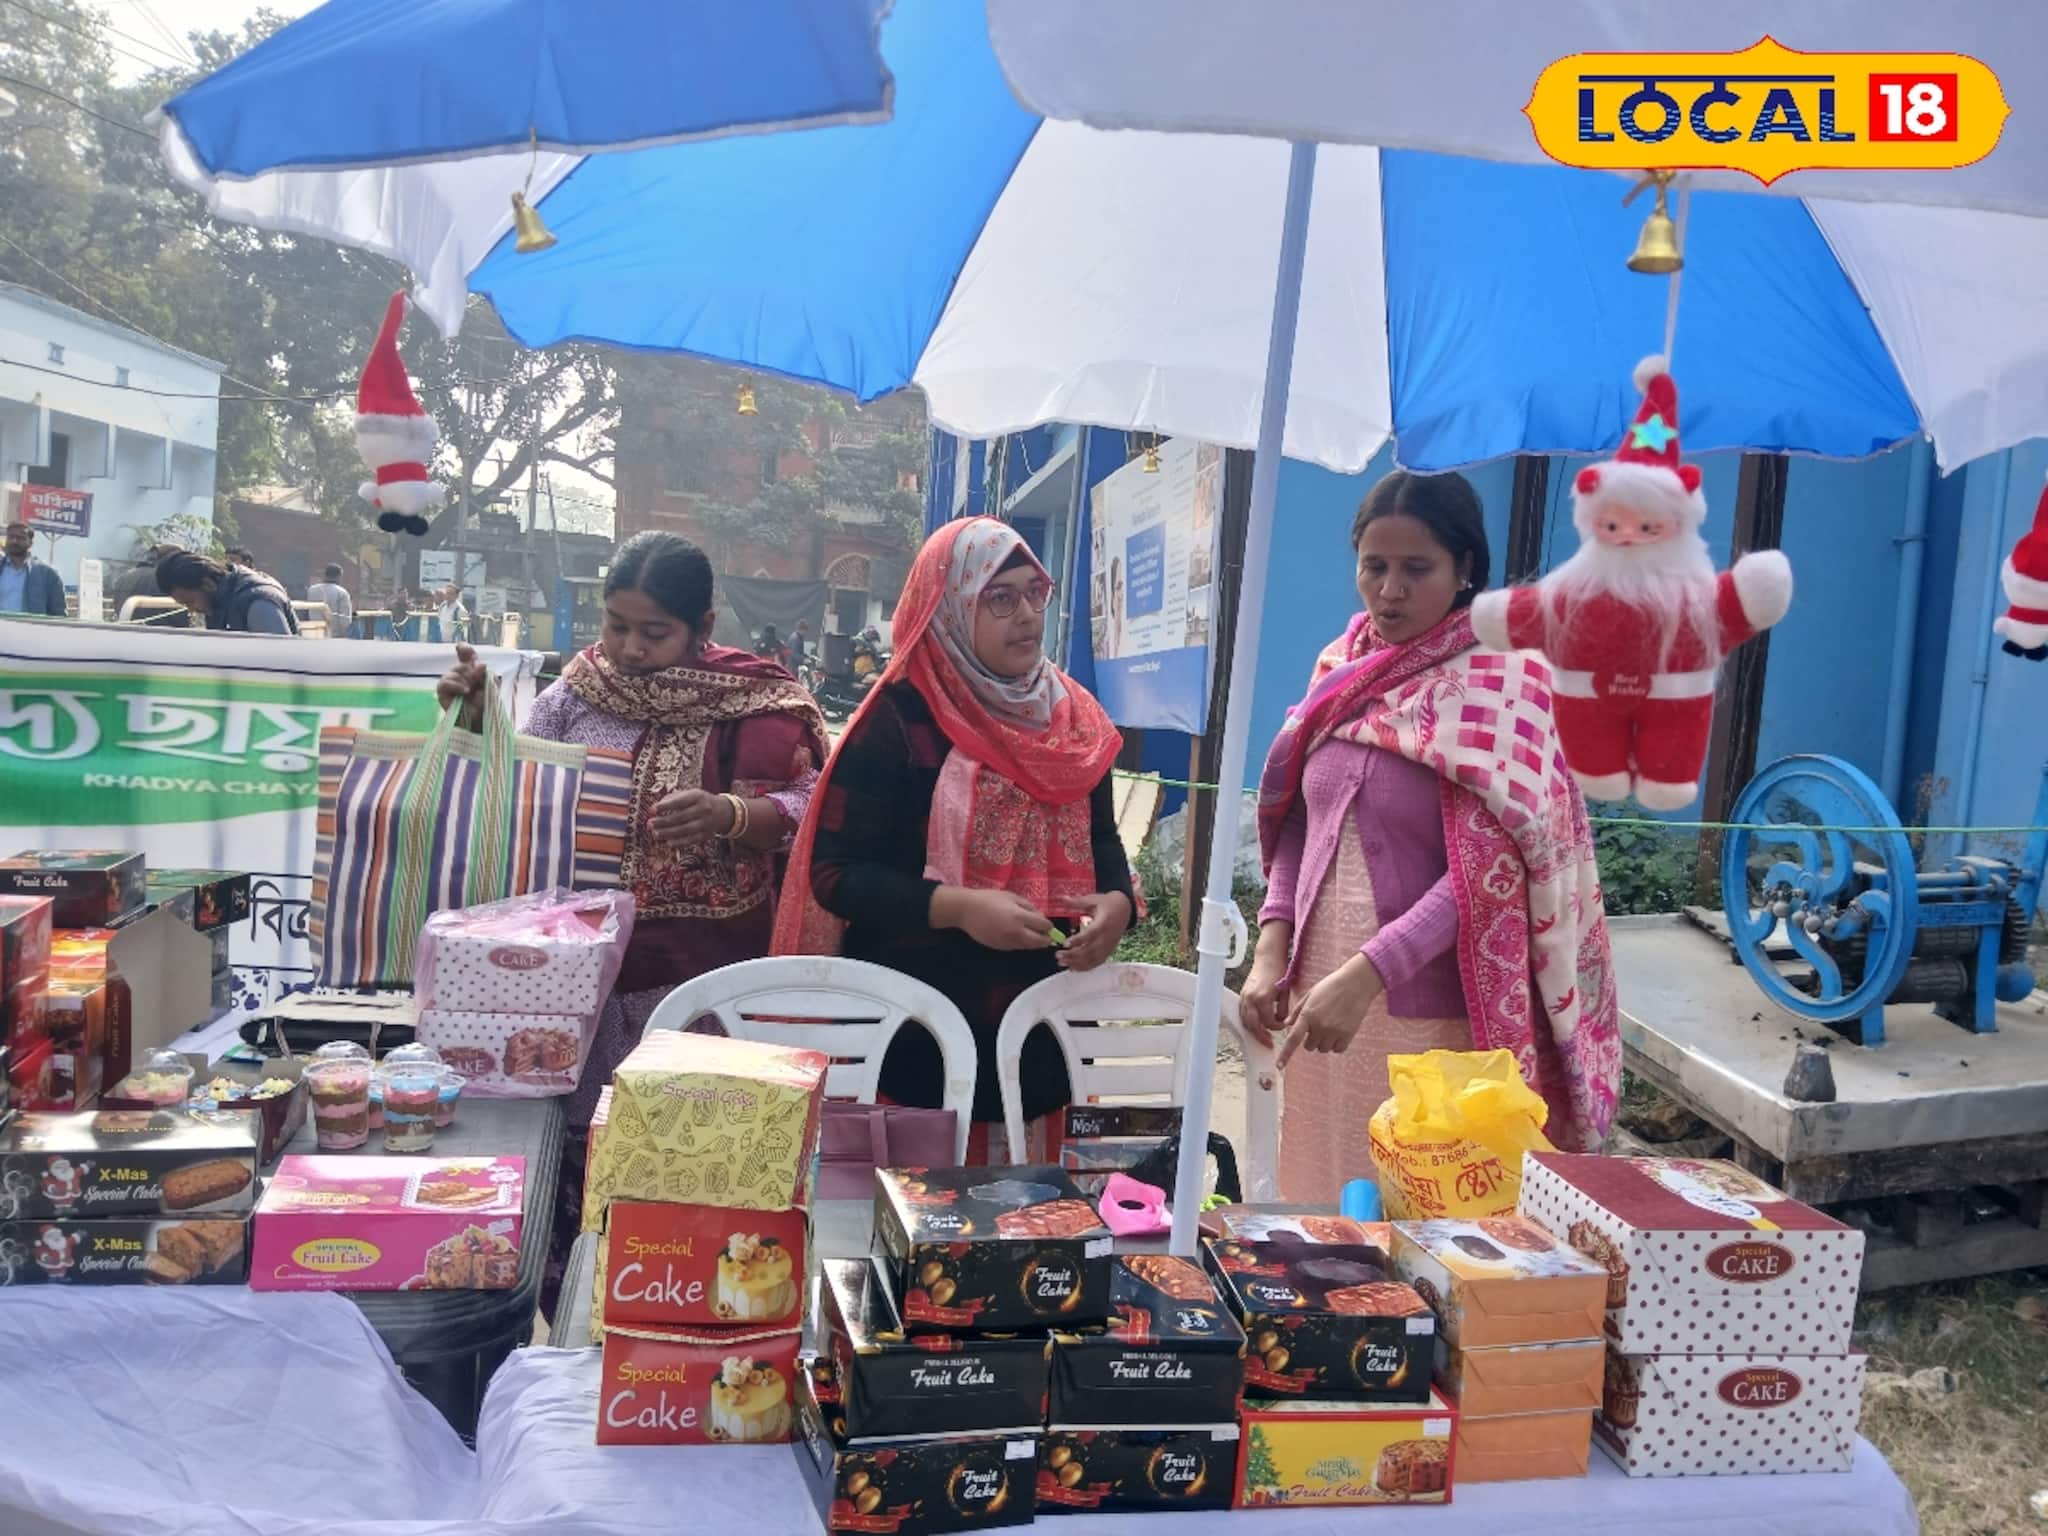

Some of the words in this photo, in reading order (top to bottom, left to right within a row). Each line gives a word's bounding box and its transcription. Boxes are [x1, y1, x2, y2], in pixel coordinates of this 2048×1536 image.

[83, 773, 215, 793] KHADYA
[13, 875, 41, 888] Fruit
[44, 875, 69, 887] Cake
[499, 955, 539, 967] CAKE
[99, 1168, 148, 1181] X-Mas
[93, 1238, 142, 1251] X-Mas
[623, 1236, 694, 1259] Special
[1736, 1246, 1772, 1257] Special
[303, 1251, 336, 1265] Fruit
[1722, 1255, 1780, 1275] CAKE
[1034, 1266, 1072, 1283] Fruit
[612, 1262, 705, 1307] Cake
[1037, 1281, 1072, 1298] Cake
[1364, 1343, 1398, 1358] Fruit
[616, 1361, 687, 1385] Special
[1109, 1361, 1150, 1378] Fruit
[1154, 1361, 1193, 1379] Cake
[1366, 1357, 1398, 1373] Cake
[910, 1369, 952, 1389] Fruit
[957, 1366, 995, 1385] Cake
[1733, 1381, 1788, 1402] CAKE
[606, 1390, 697, 1431] Cake
[1161, 1453, 1196, 1469] Fruit
[962, 1470, 998, 1485] Fruit
[1163, 1468, 1196, 1483] Cake
[964, 1485, 998, 1500] Cake
[1289, 1484, 1332, 1498] Fruit
